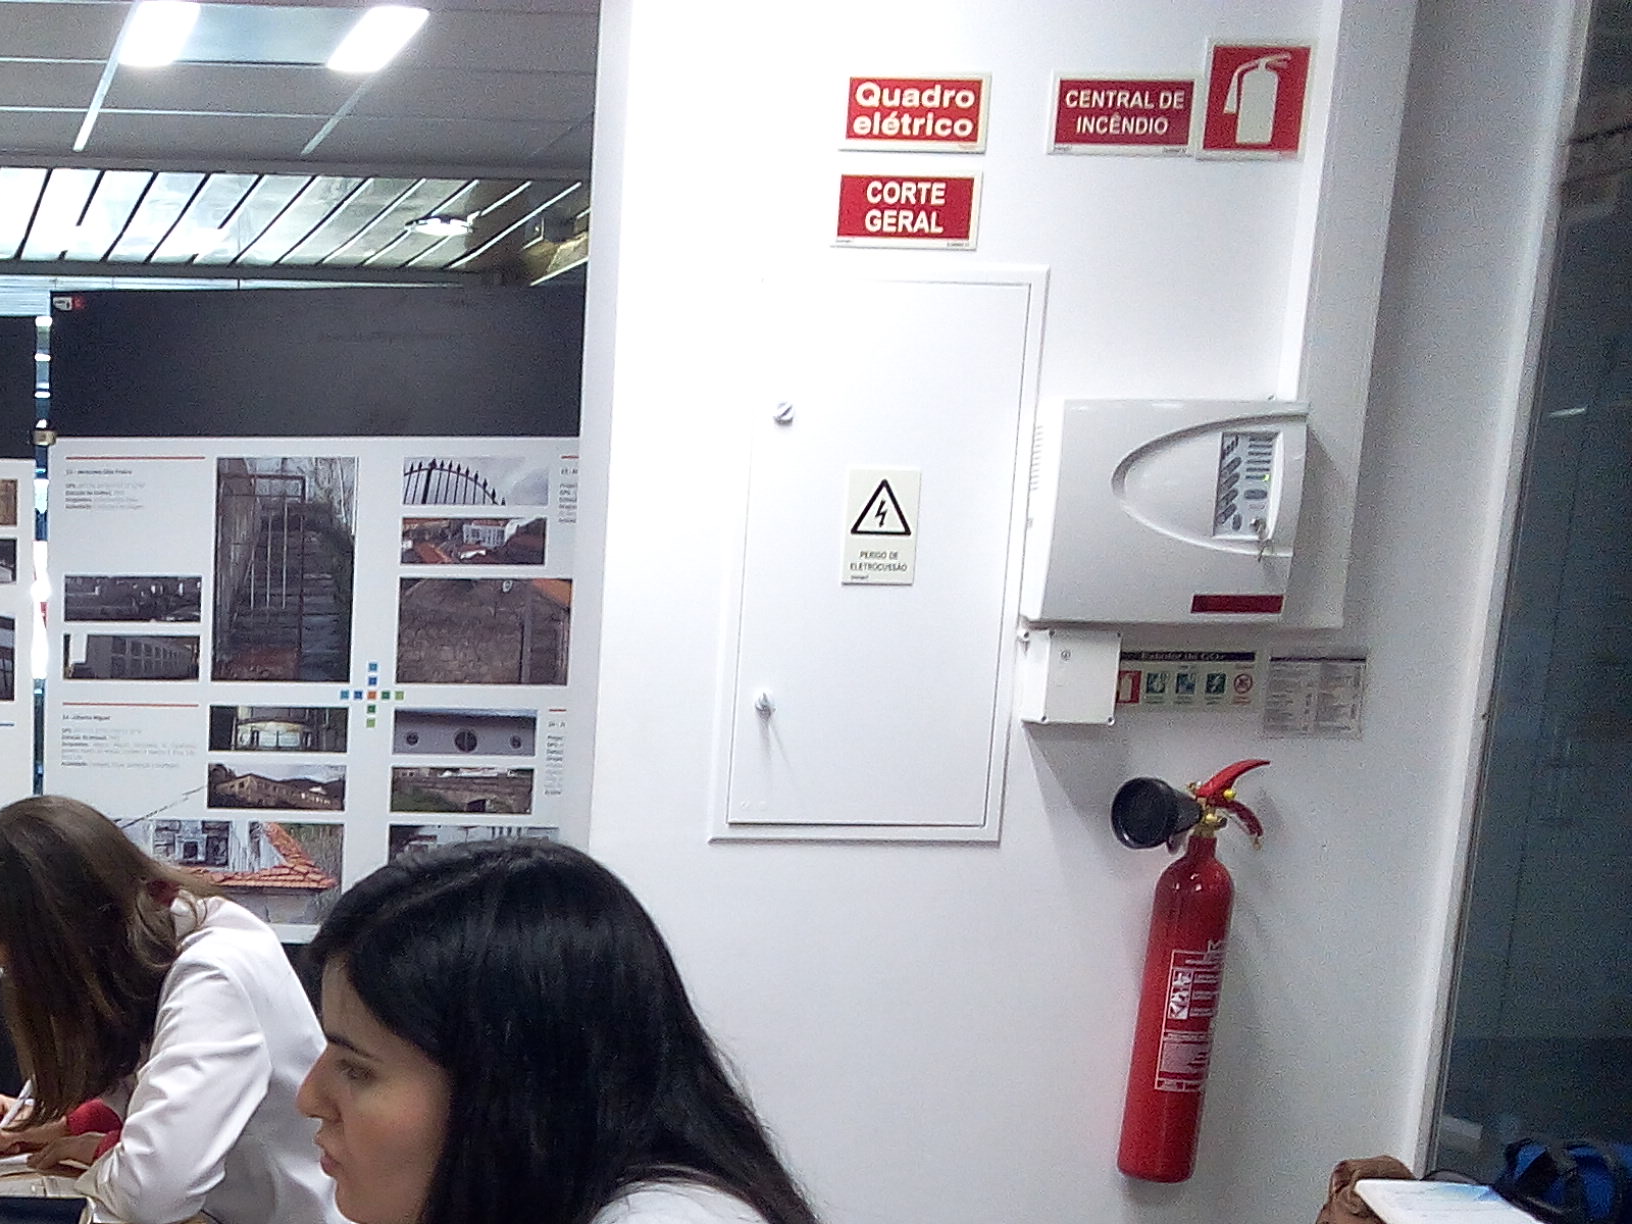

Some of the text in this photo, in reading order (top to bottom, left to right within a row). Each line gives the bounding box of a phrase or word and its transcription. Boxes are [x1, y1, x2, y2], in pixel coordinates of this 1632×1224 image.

[855, 81, 975, 108] Quadro
[1065, 89, 1185, 109] CENTRAL DE
[853, 111, 973, 137] elétrico
[1076, 111, 1168, 135] INCÊNDIO
[866, 180, 946, 205] CORTE
[865, 208, 944, 234] GERAL
